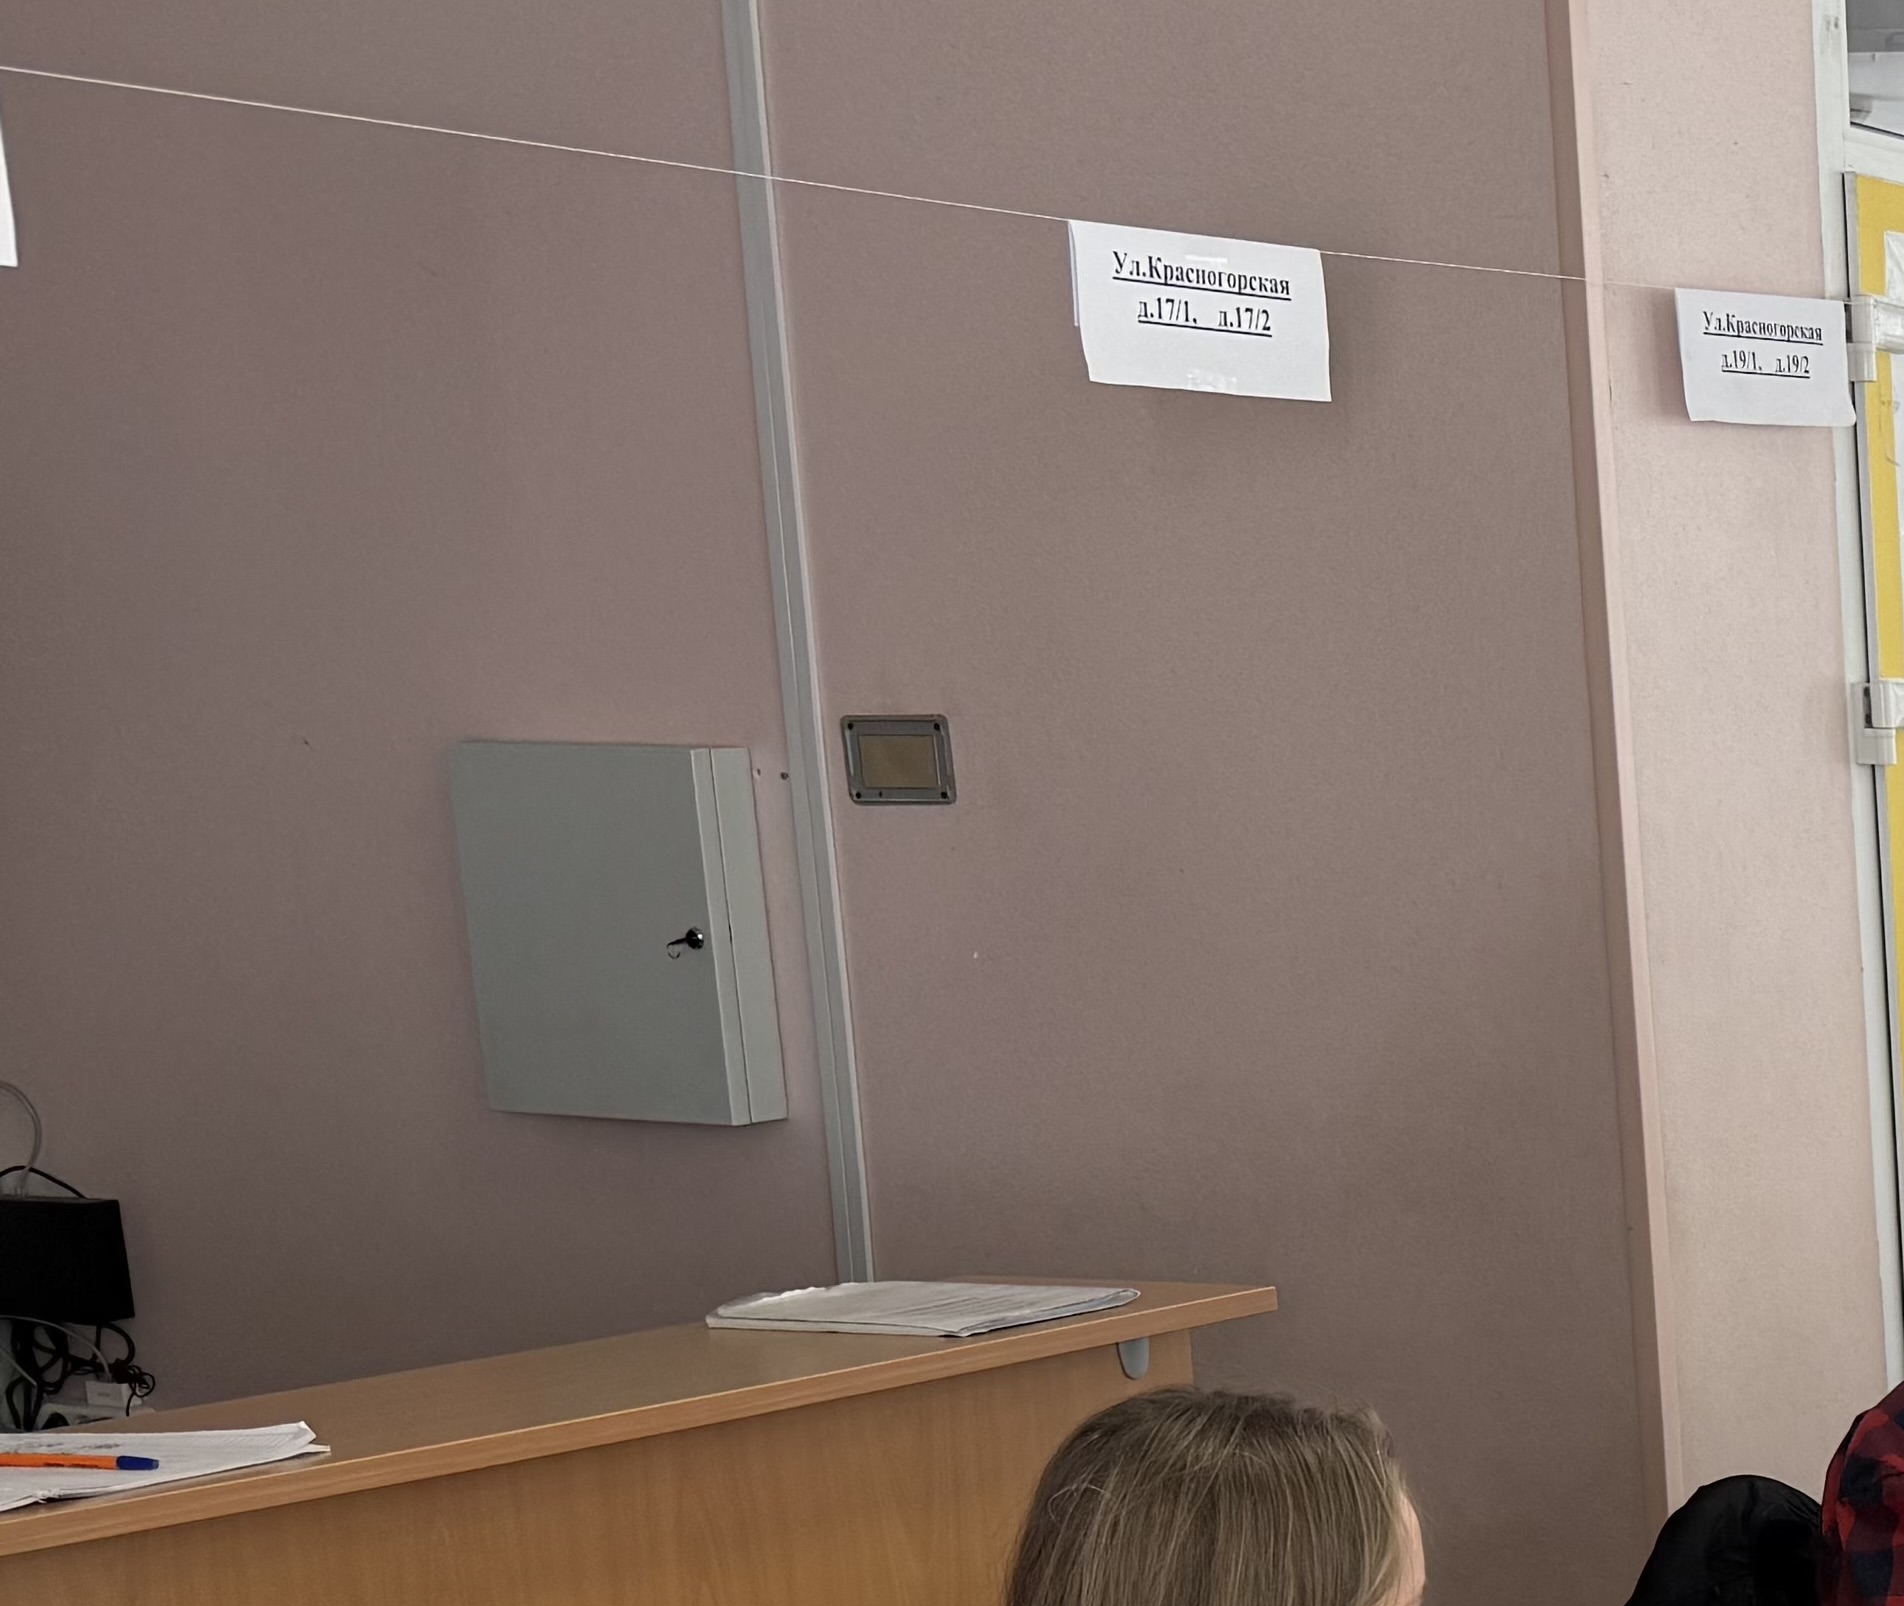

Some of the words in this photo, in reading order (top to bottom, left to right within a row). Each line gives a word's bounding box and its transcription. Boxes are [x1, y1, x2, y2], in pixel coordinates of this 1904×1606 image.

[1113, 251, 1290, 296] Ул.Красногорская
[1217, 306, 1271, 334] д.17/2
[1703, 310, 1823, 343] Ул.Красногорская
[1775, 354, 1810, 376] д.19/2
